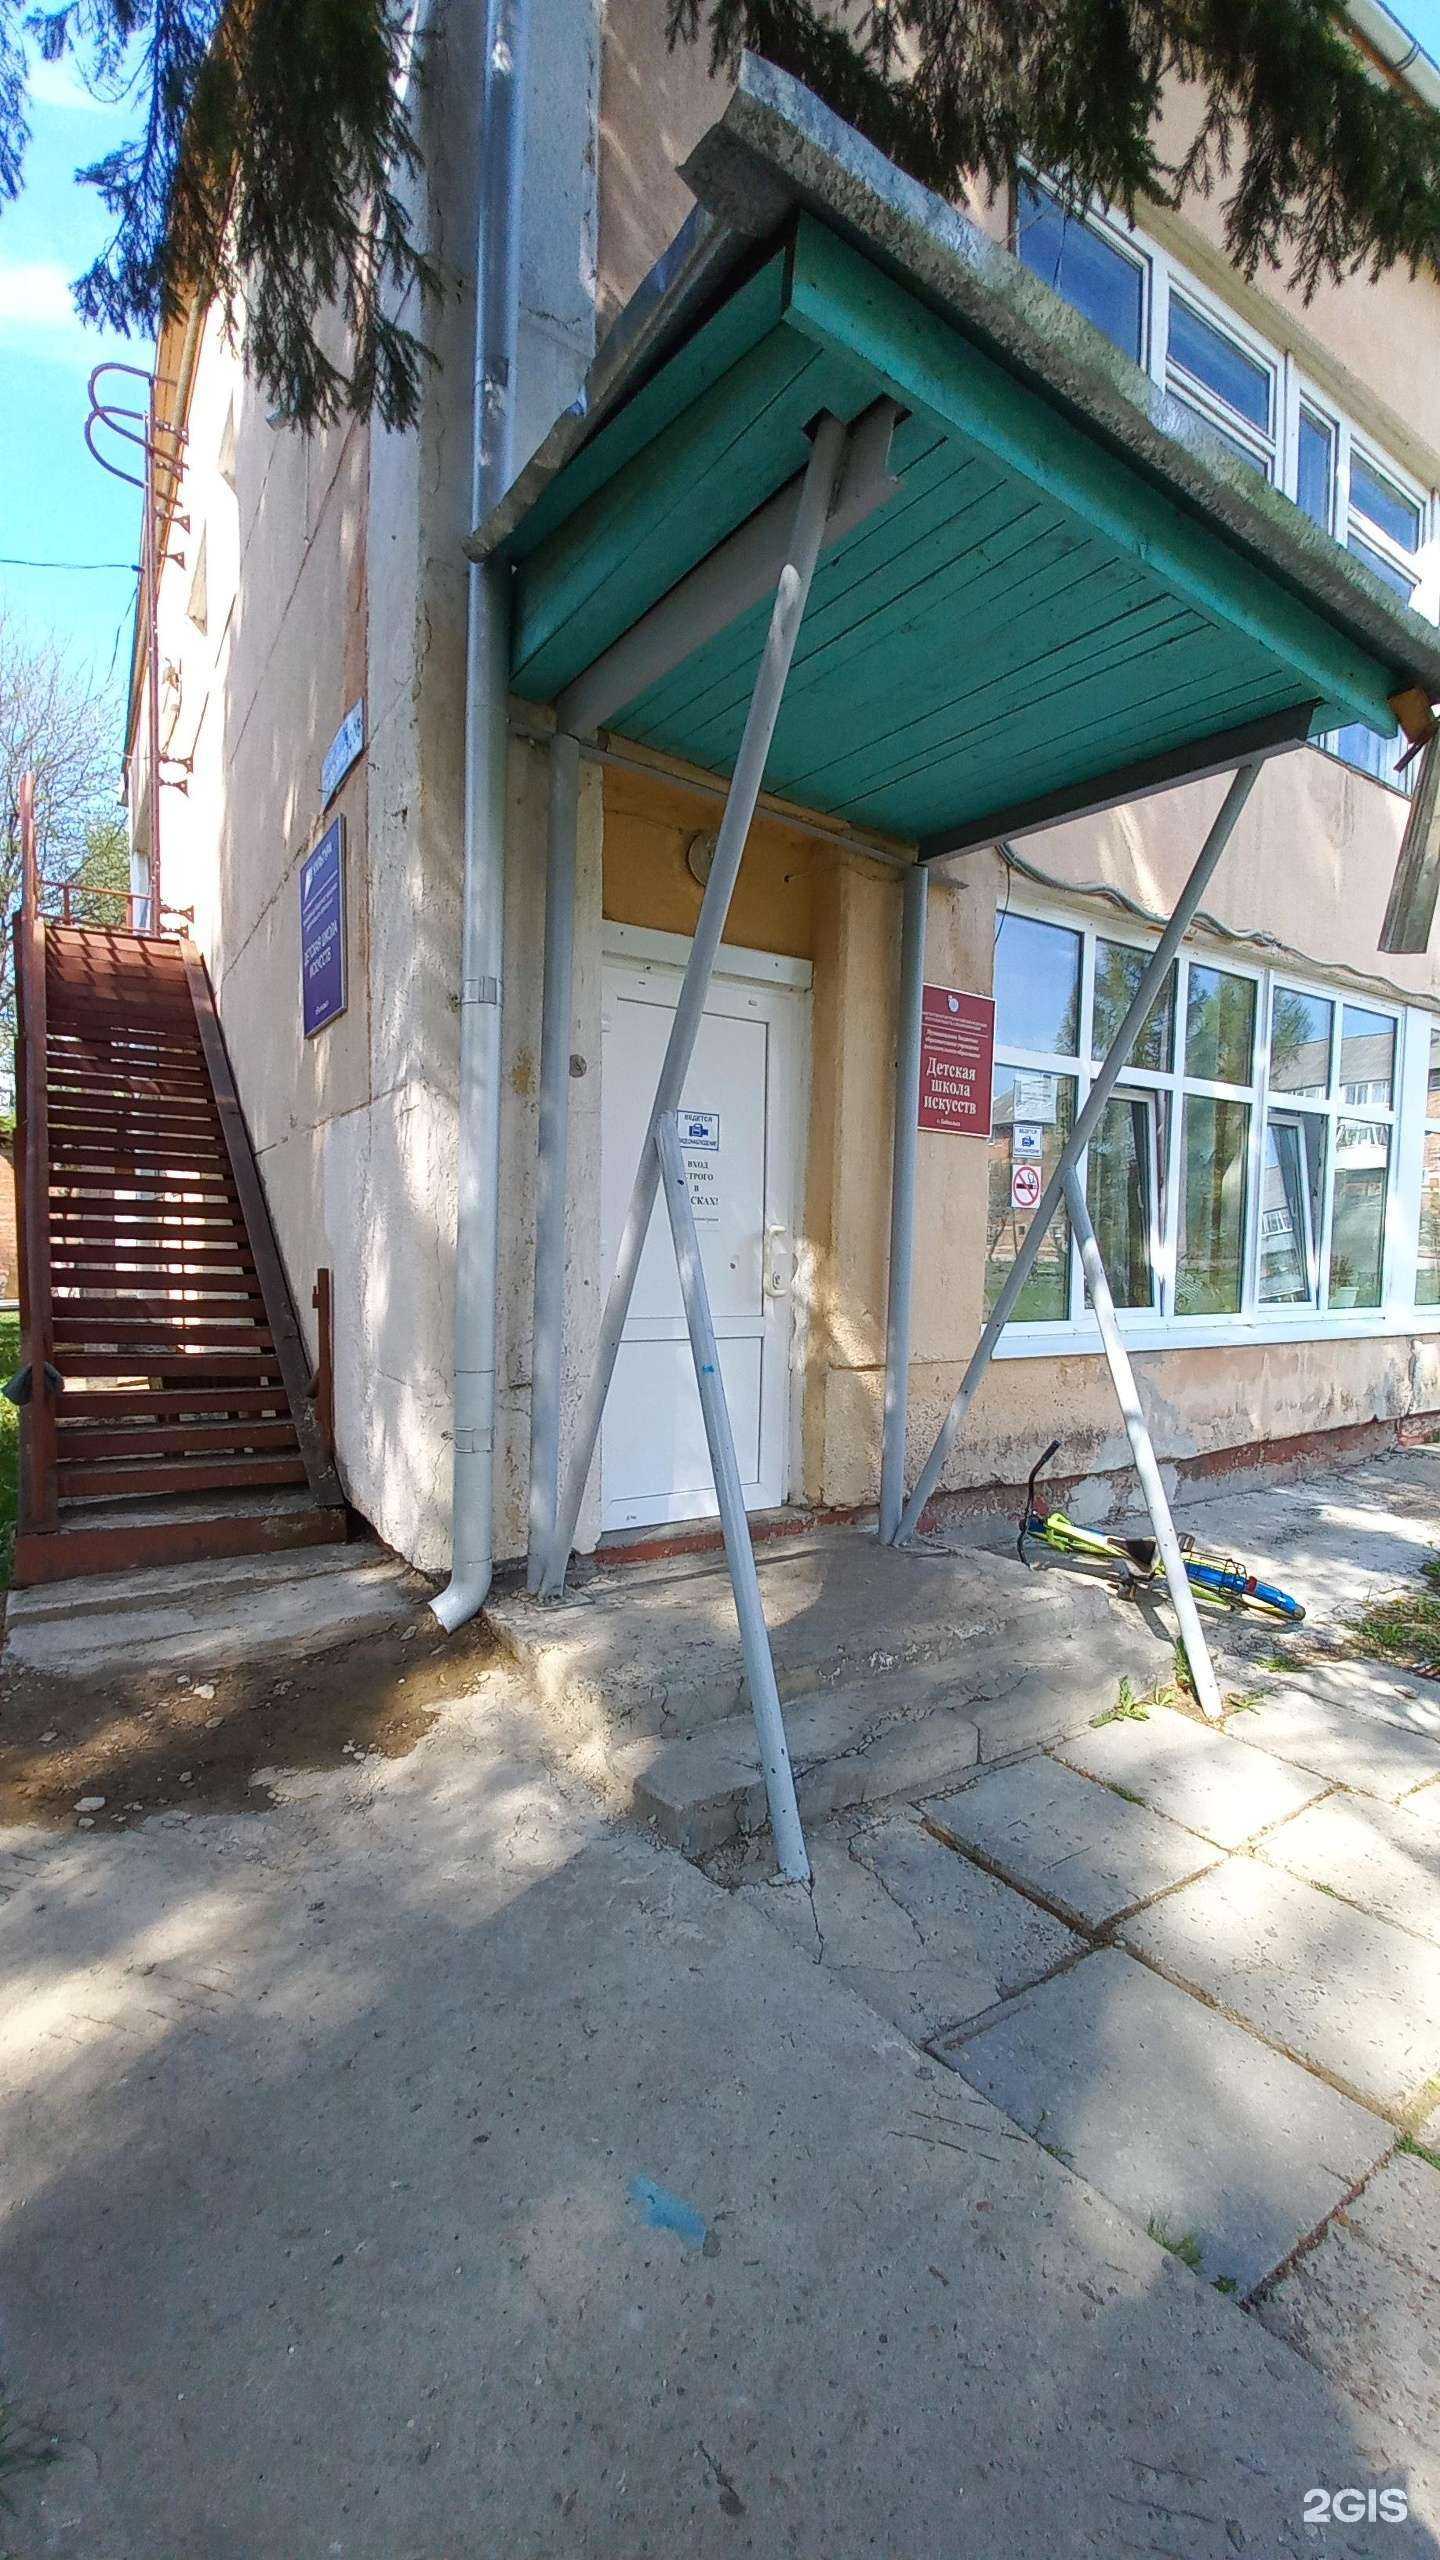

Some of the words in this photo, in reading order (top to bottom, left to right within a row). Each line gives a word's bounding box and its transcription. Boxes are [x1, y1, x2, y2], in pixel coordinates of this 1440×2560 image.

[926, 1056, 976, 1080] Детская
[931, 1079, 970, 1097] школа
[923, 1095, 977, 1115] искусств
[687, 1160, 709, 1169] ВХОД
[690, 1195, 719, 1206] СКАХ!
